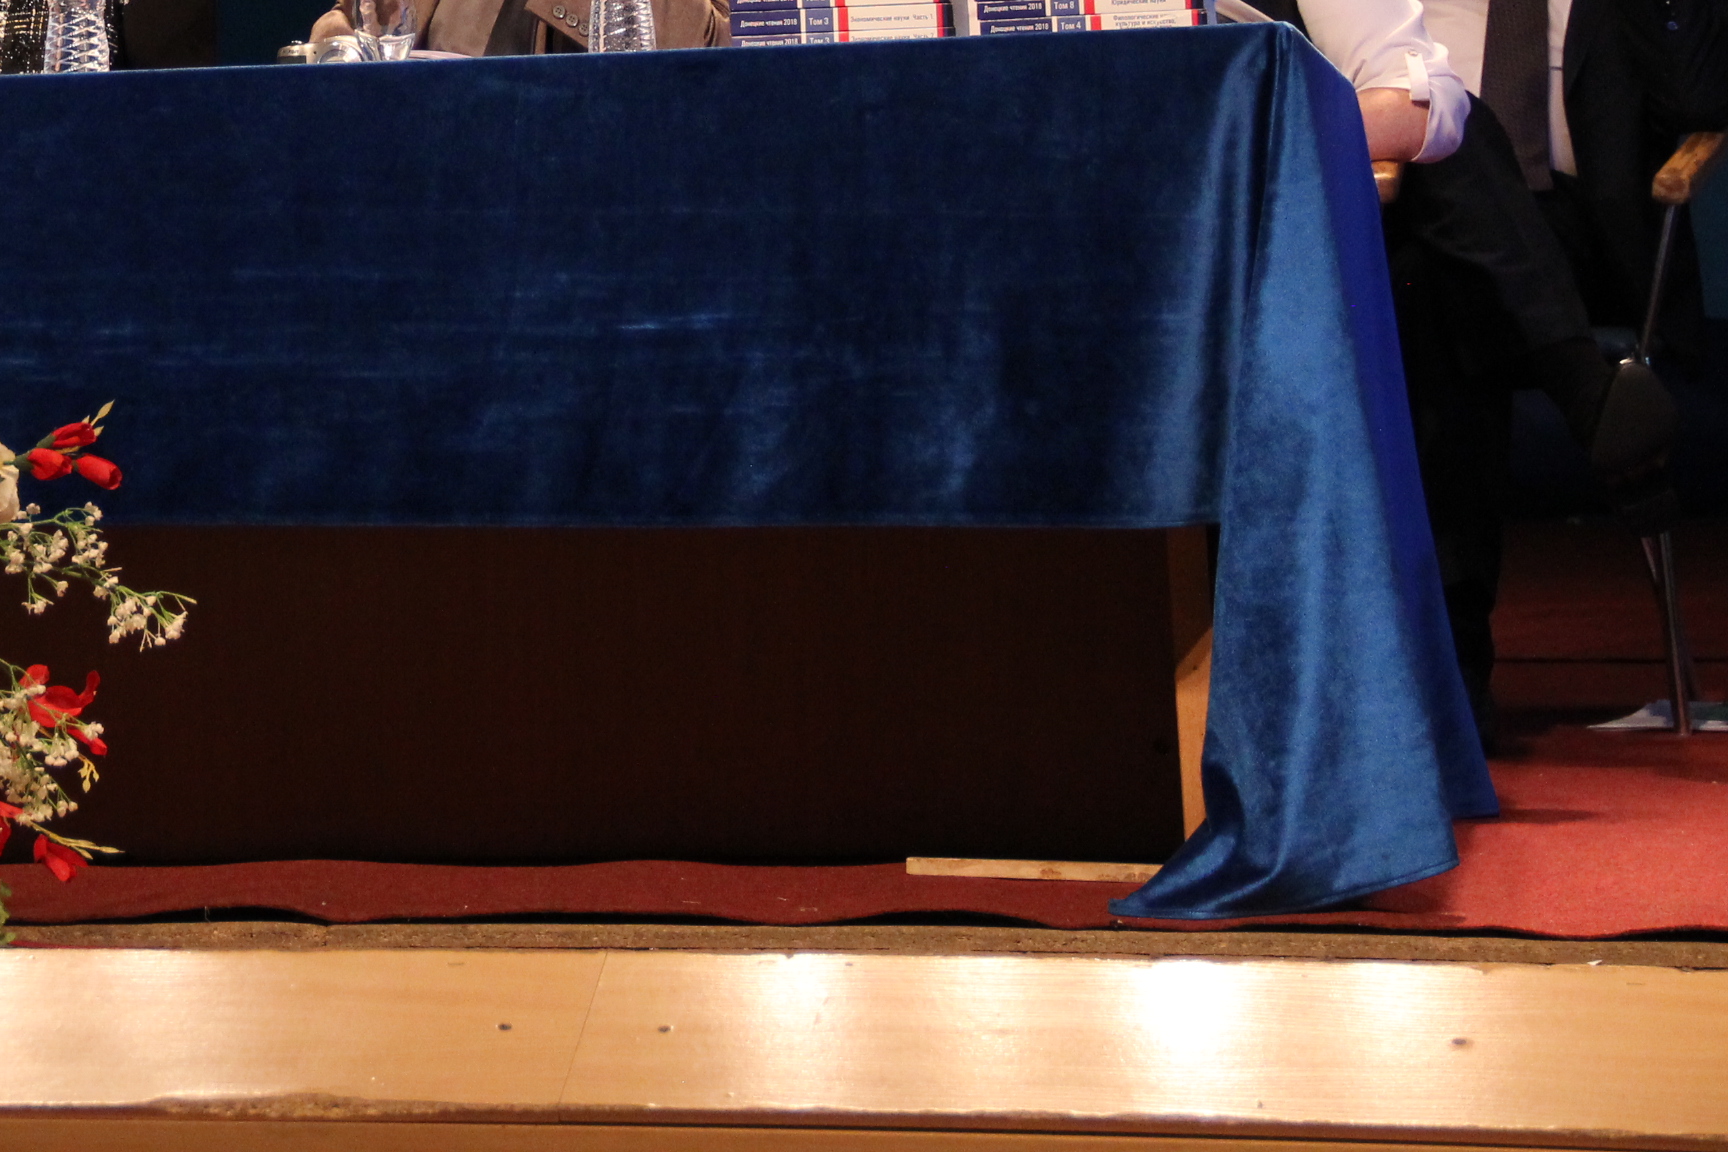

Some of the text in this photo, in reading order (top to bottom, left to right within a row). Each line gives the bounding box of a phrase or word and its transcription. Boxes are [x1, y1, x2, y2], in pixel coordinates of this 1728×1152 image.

[1054, 1, 1075, 10] Том 8
[808, 17, 829, 26] Том 3
[1061, 21, 1082, 30] Том 4
